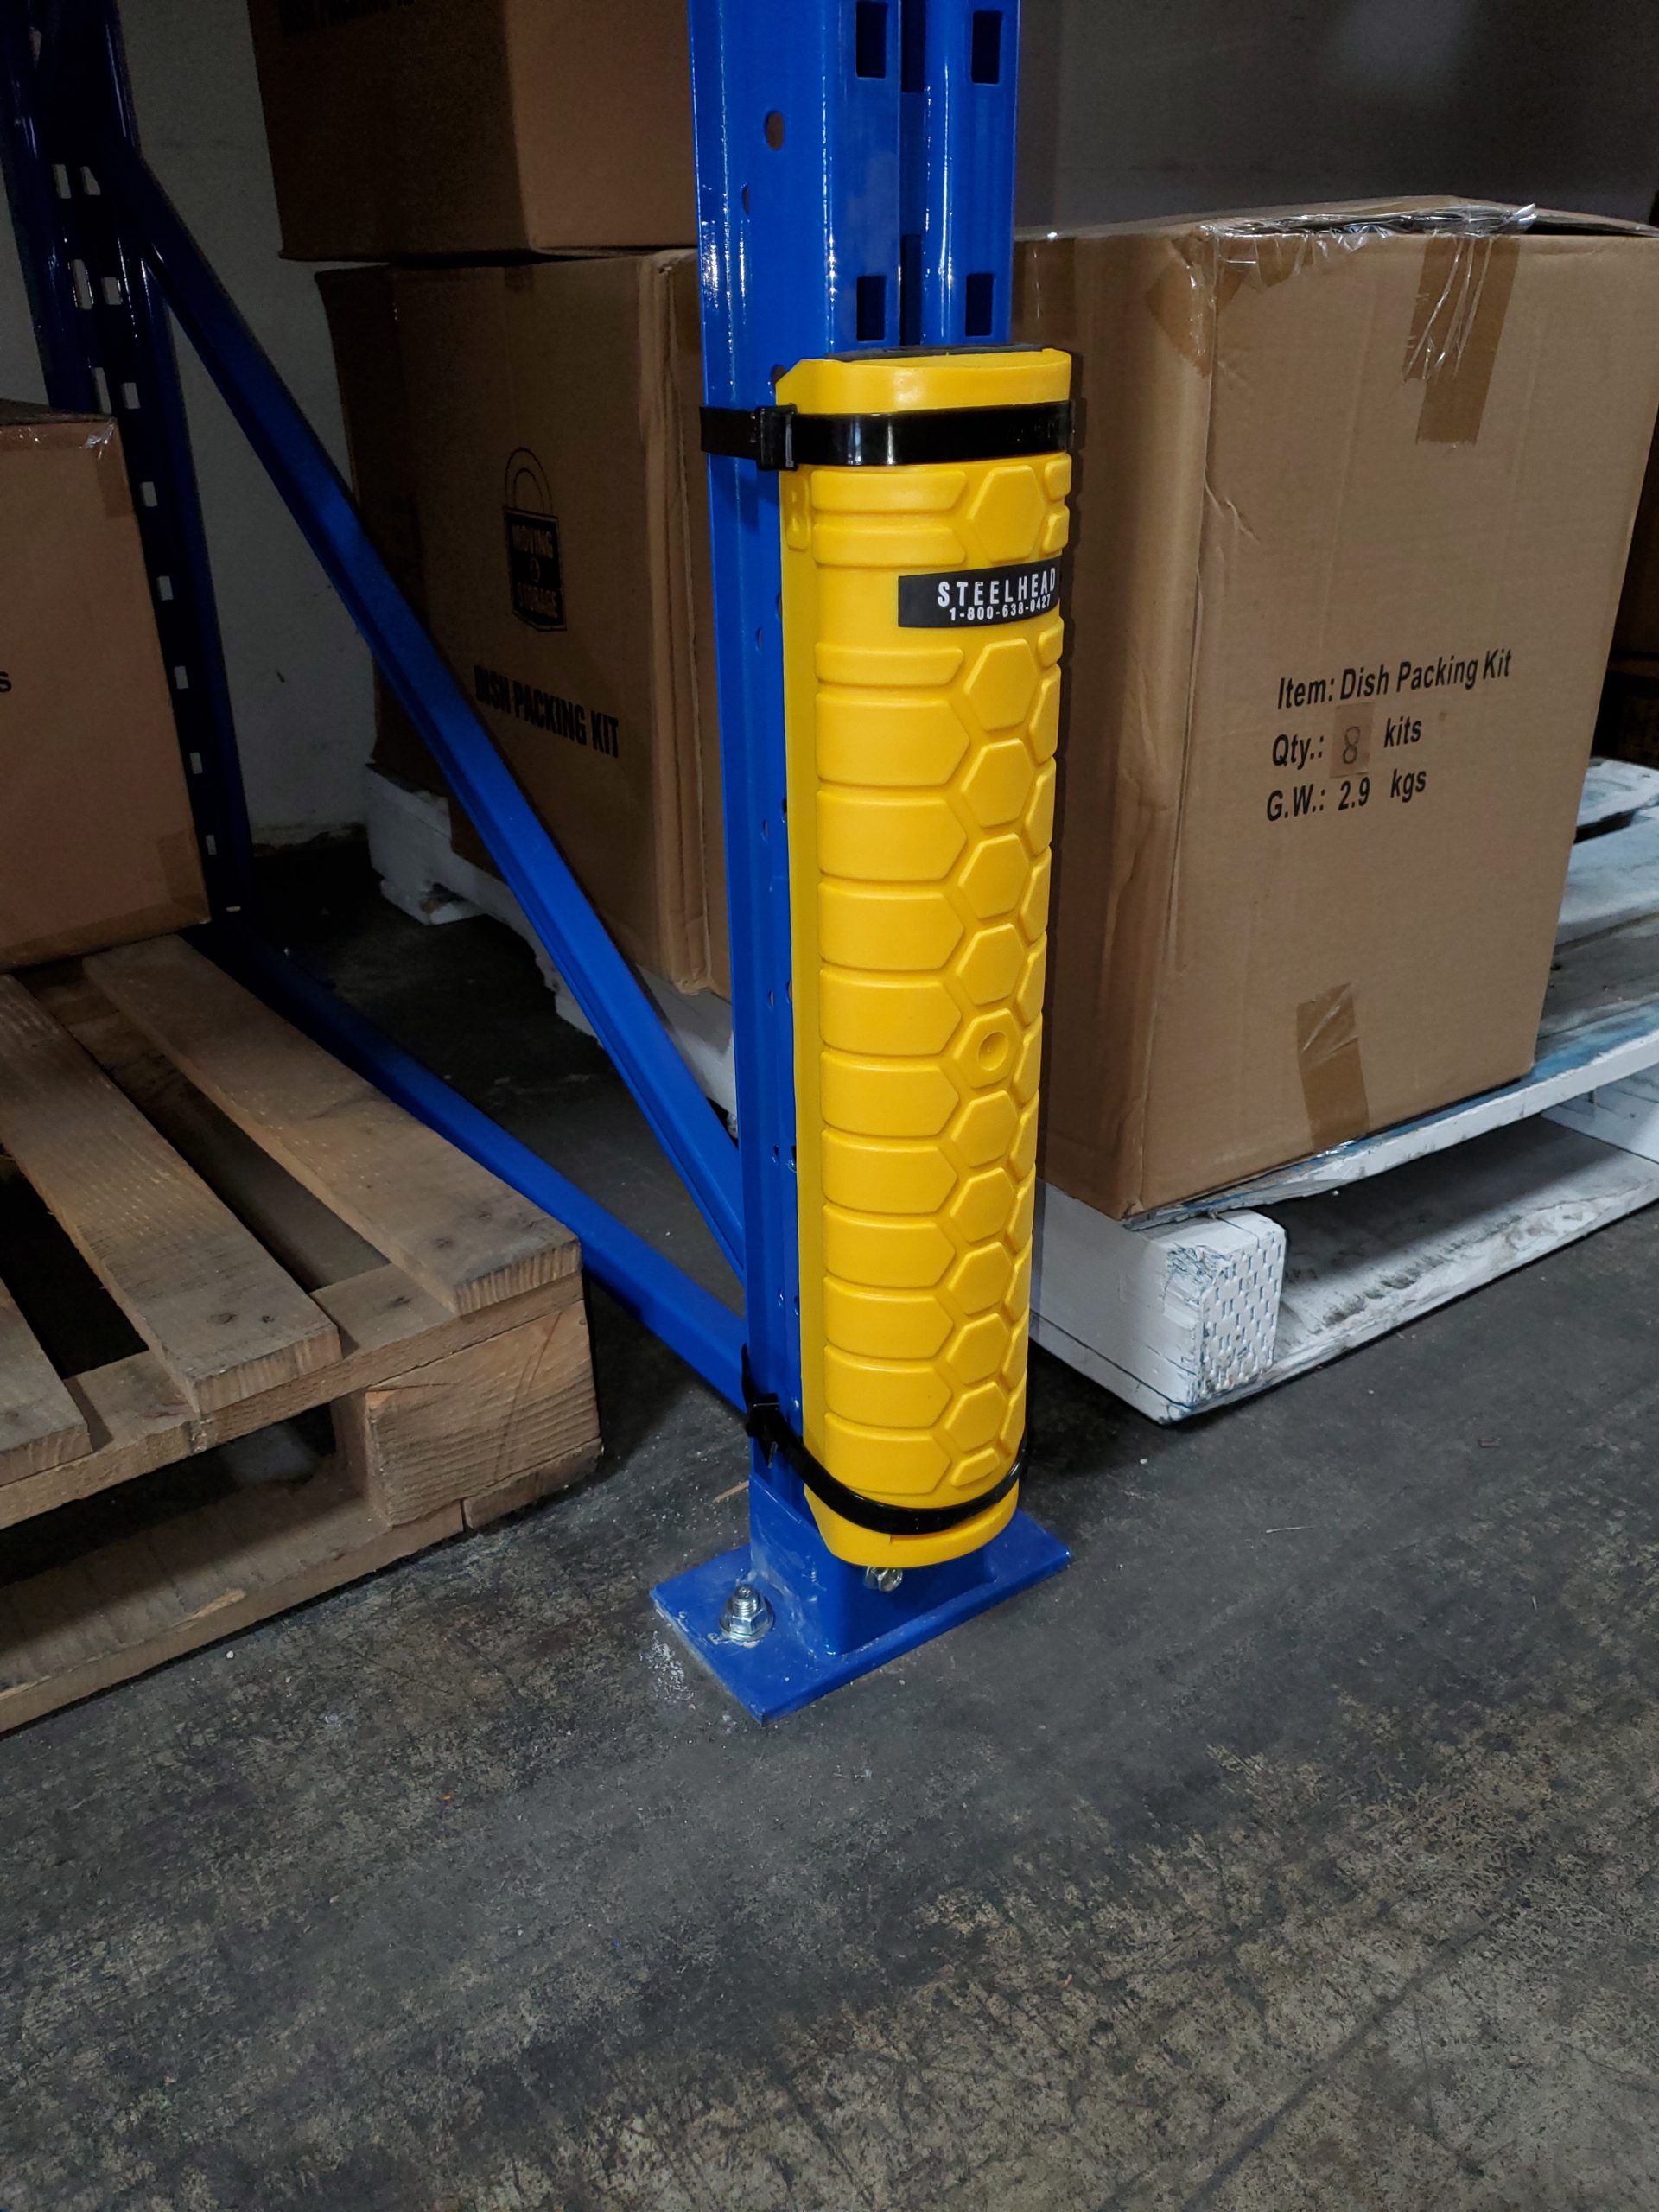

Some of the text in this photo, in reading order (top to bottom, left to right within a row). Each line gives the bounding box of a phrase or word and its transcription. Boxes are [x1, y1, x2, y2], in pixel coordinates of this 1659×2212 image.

[938, 568, 1056, 607] STEELHEAD
[949, 594, 1052, 621] 1-800-638-0427
[1278, 648, 1512, 709] Item: Dish Packing Kit
[474, 664, 620, 759] DISH PACKING KIT
[1272, 716, 1422, 771] Qty.: 8 kits
[1267, 768, 1427, 822] G.W.: 2.9 kgs
